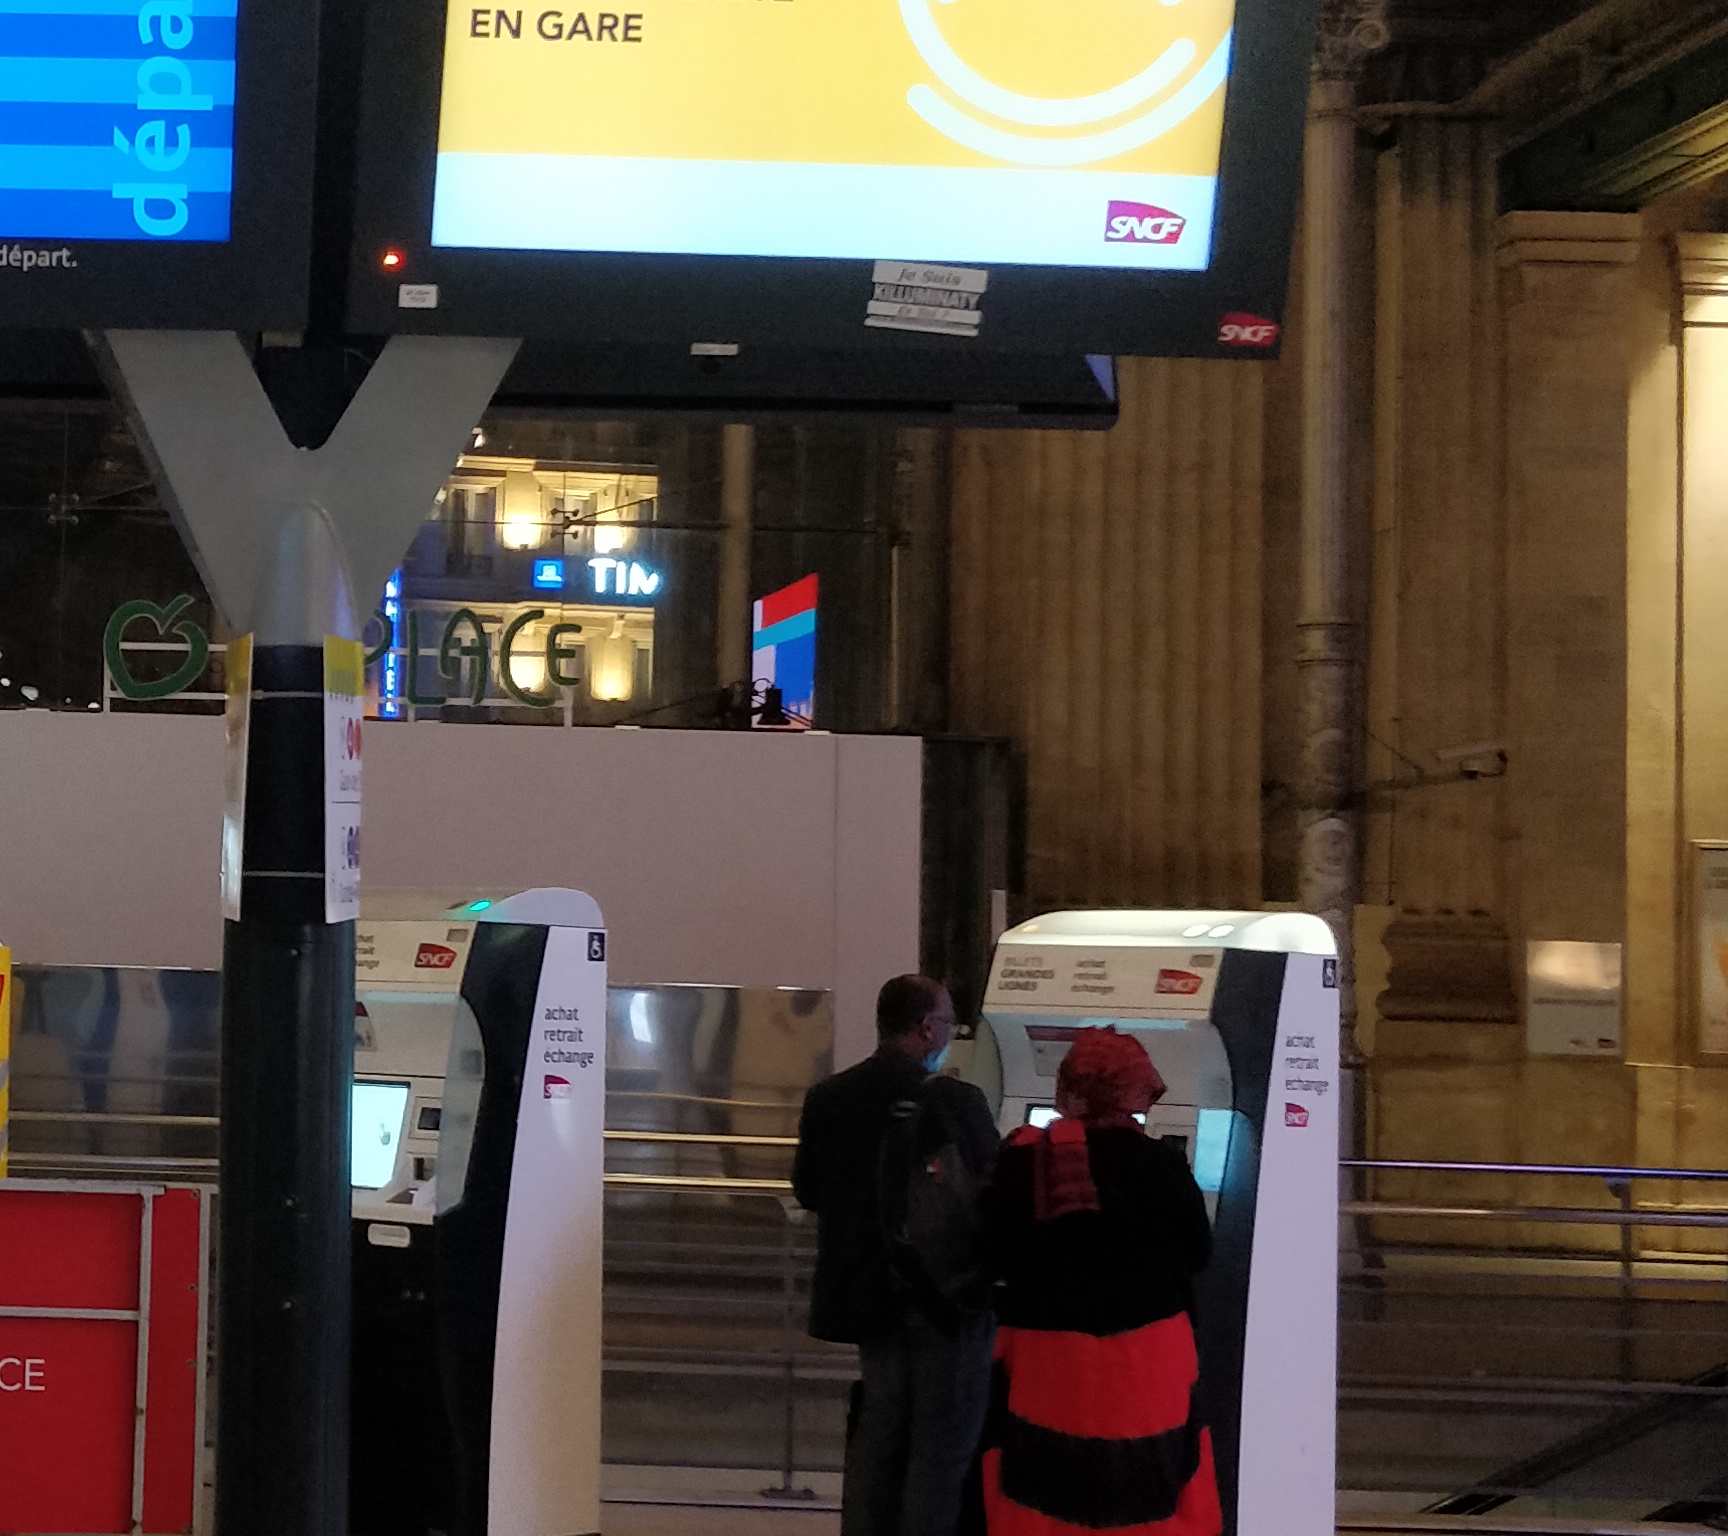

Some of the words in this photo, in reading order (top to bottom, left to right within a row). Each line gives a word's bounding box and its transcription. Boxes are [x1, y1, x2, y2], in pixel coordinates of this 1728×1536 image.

[469, 9, 523, 40] EN
[536, 10, 644, 44] GARE
[1106, 215, 1181, 241] SNCF
[1218, 322, 1274, 343] SNCF
[418, 953, 455, 966] SNCF
[544, 1007, 579, 1021] achat
[543, 1028, 584, 1042] retrait
[543, 1048, 594, 1068] échange
